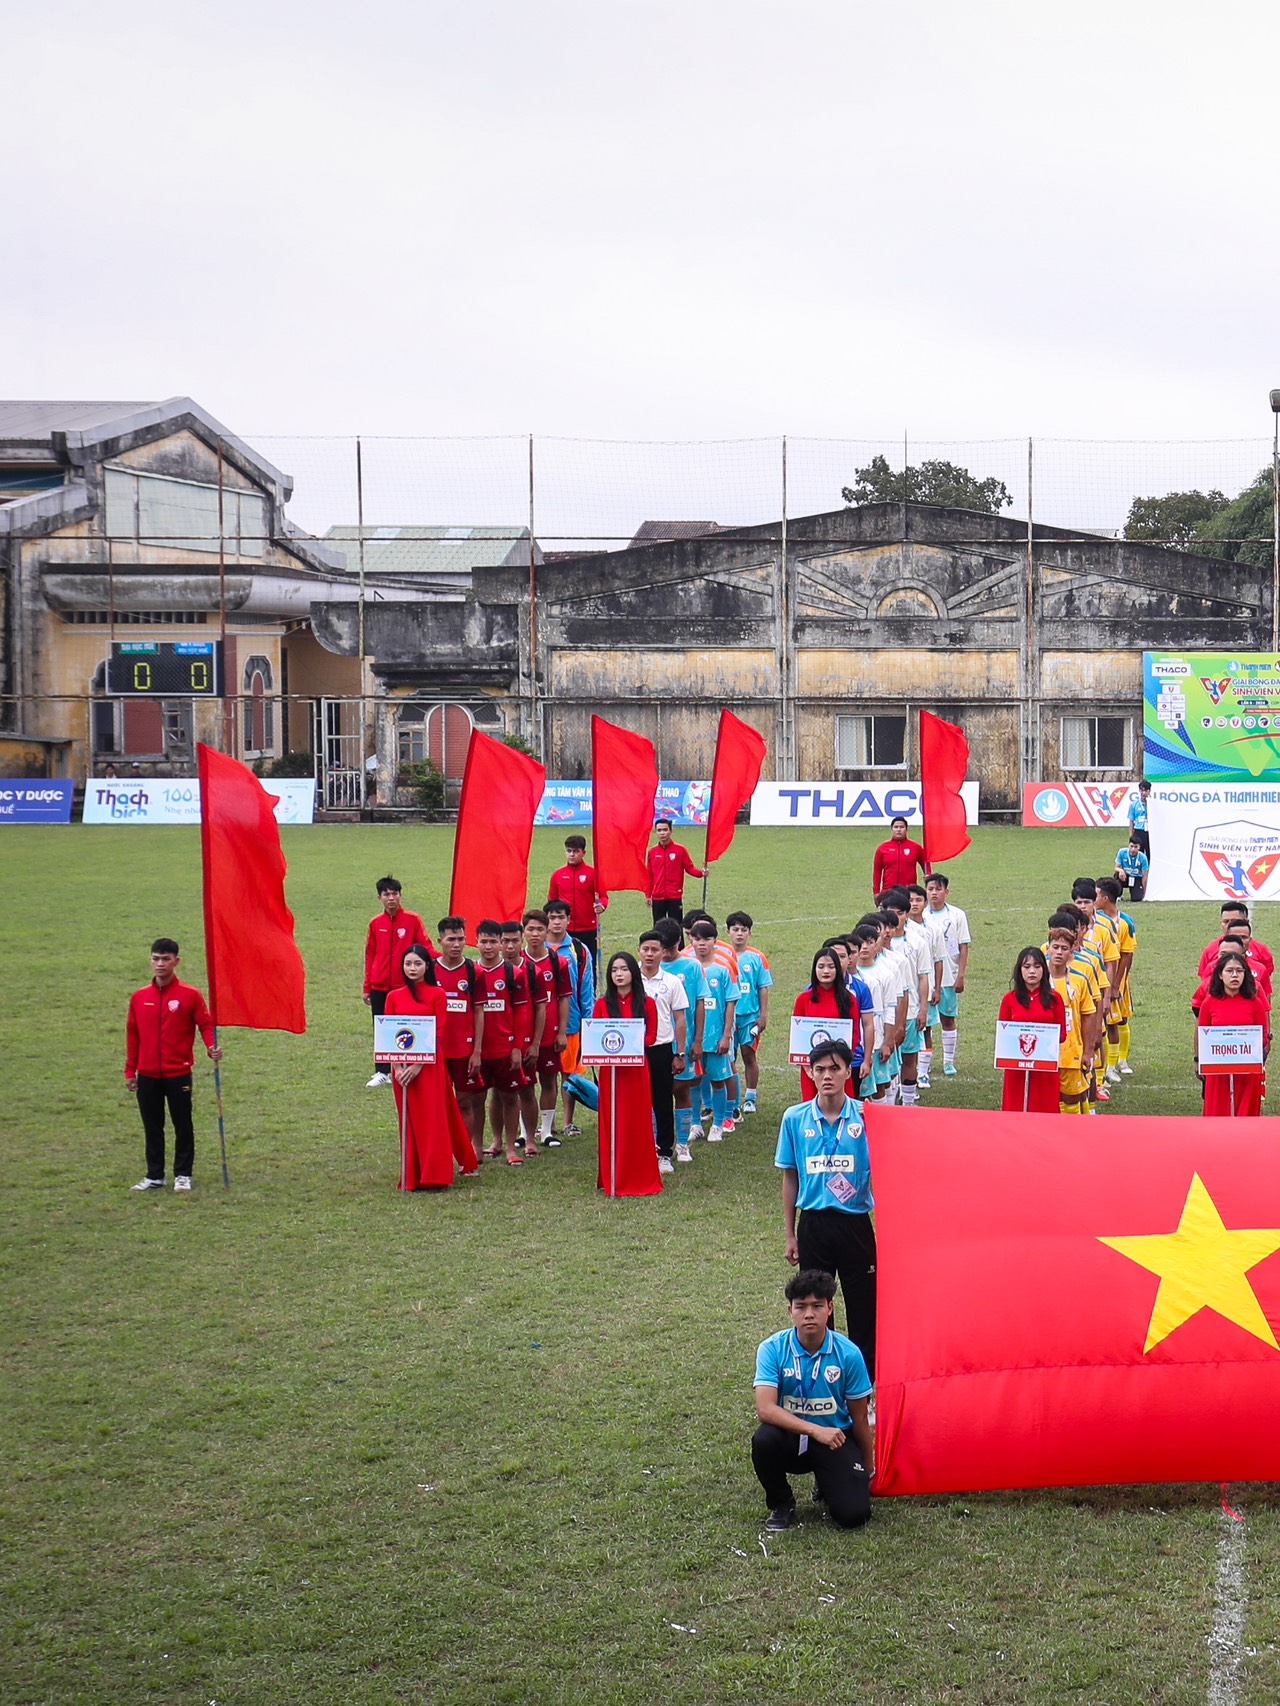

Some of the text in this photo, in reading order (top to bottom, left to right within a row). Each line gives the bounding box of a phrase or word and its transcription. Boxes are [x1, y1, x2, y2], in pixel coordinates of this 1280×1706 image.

[134, 662, 150, 690] 0
[191, 662, 207, 690] 0
[15, 790, 25, 800] Y
[26, 790, 64, 803] DƯỢC
[662, 788, 680, 797] THAO
[1202, 789, 1222, 803] ĐÁ
[778, 790, 924, 818] THAC
[1199, 842, 1219, 850] SINH
[1210, 1041, 1252, 1057] TRỌNG TÀI
[811, 1160, 850, 1168] THACO
[788, 1400, 833, 1412] THACO
